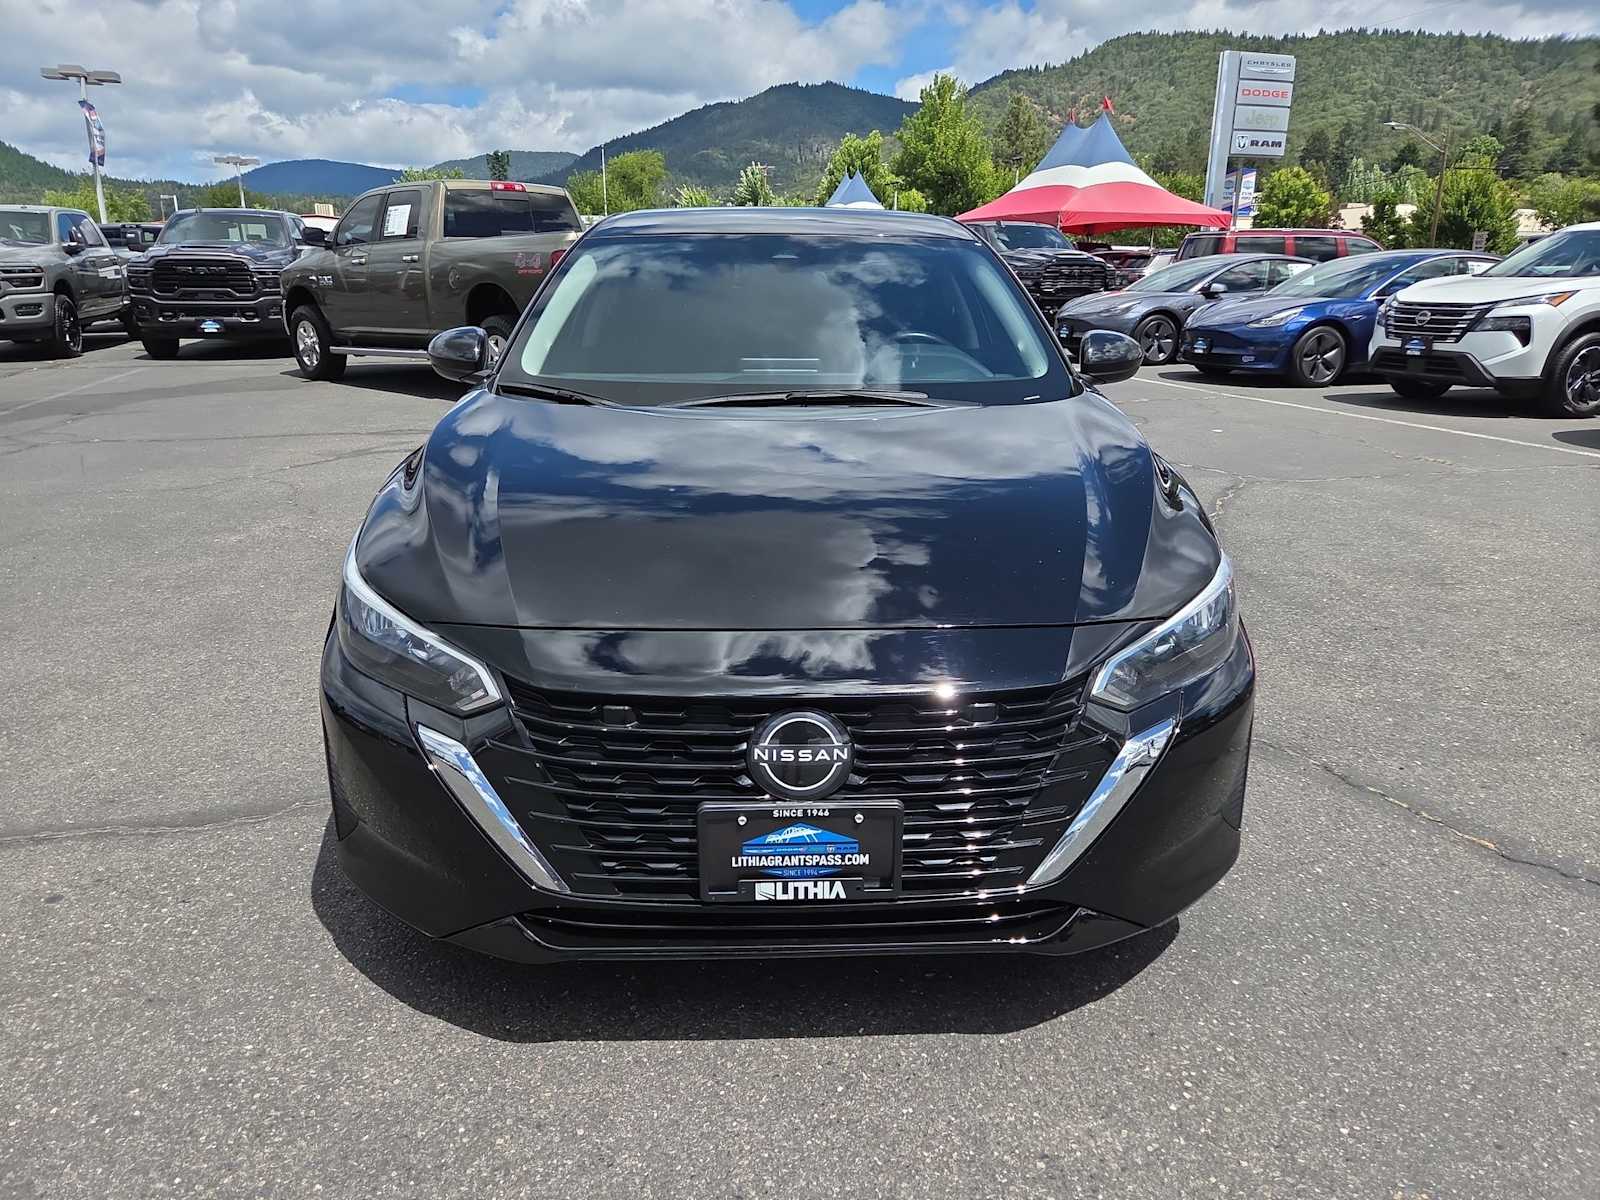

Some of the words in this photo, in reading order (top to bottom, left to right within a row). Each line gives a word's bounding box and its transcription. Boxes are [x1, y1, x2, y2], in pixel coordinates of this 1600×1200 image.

[1247, 60, 1291, 68] CHRYSLER
[1241, 88, 1289, 98] DODGE
[1250, 140, 1282, 148] RAM
[754, 748, 848, 762] NISSAN
[773, 809, 803, 818] SINCE
[807, 808, 830, 817] 1946
[732, 854, 870, 868] LITHIAGRANTSPASS.COM
[776, 881, 846, 900] LITHIA
